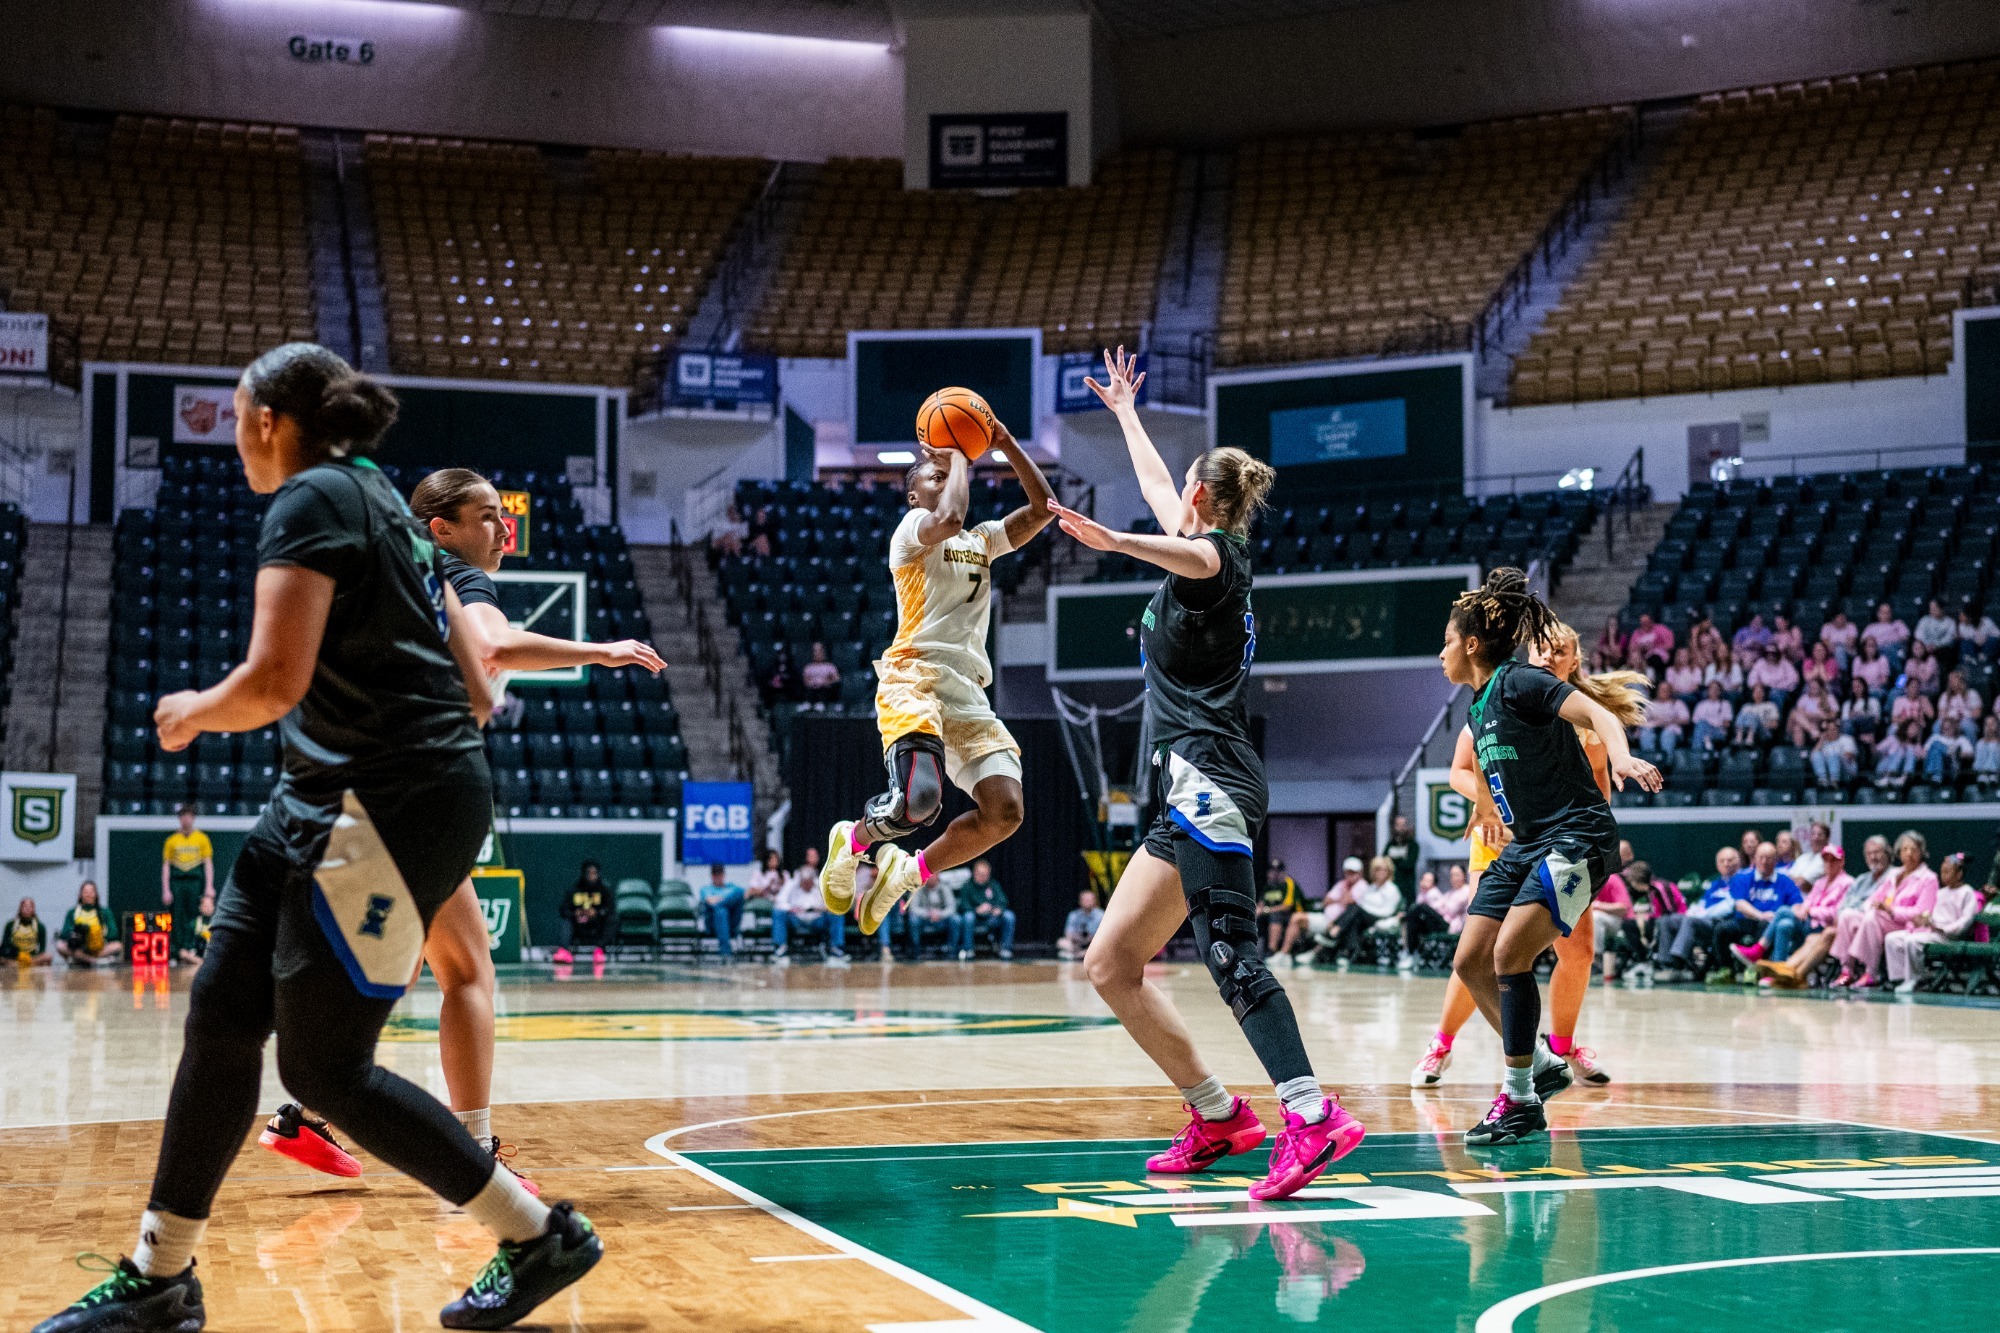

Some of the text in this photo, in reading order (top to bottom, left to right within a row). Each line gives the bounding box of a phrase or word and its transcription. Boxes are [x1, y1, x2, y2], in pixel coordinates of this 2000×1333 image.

[289, 36, 374, 64] Gate 6
[966, 572, 982, 603] 7
[23, 797, 51, 831] S
[685, 804, 750, 831] FGB
[1440, 793, 1465, 827] S
[132, 932, 169, 965] 20
